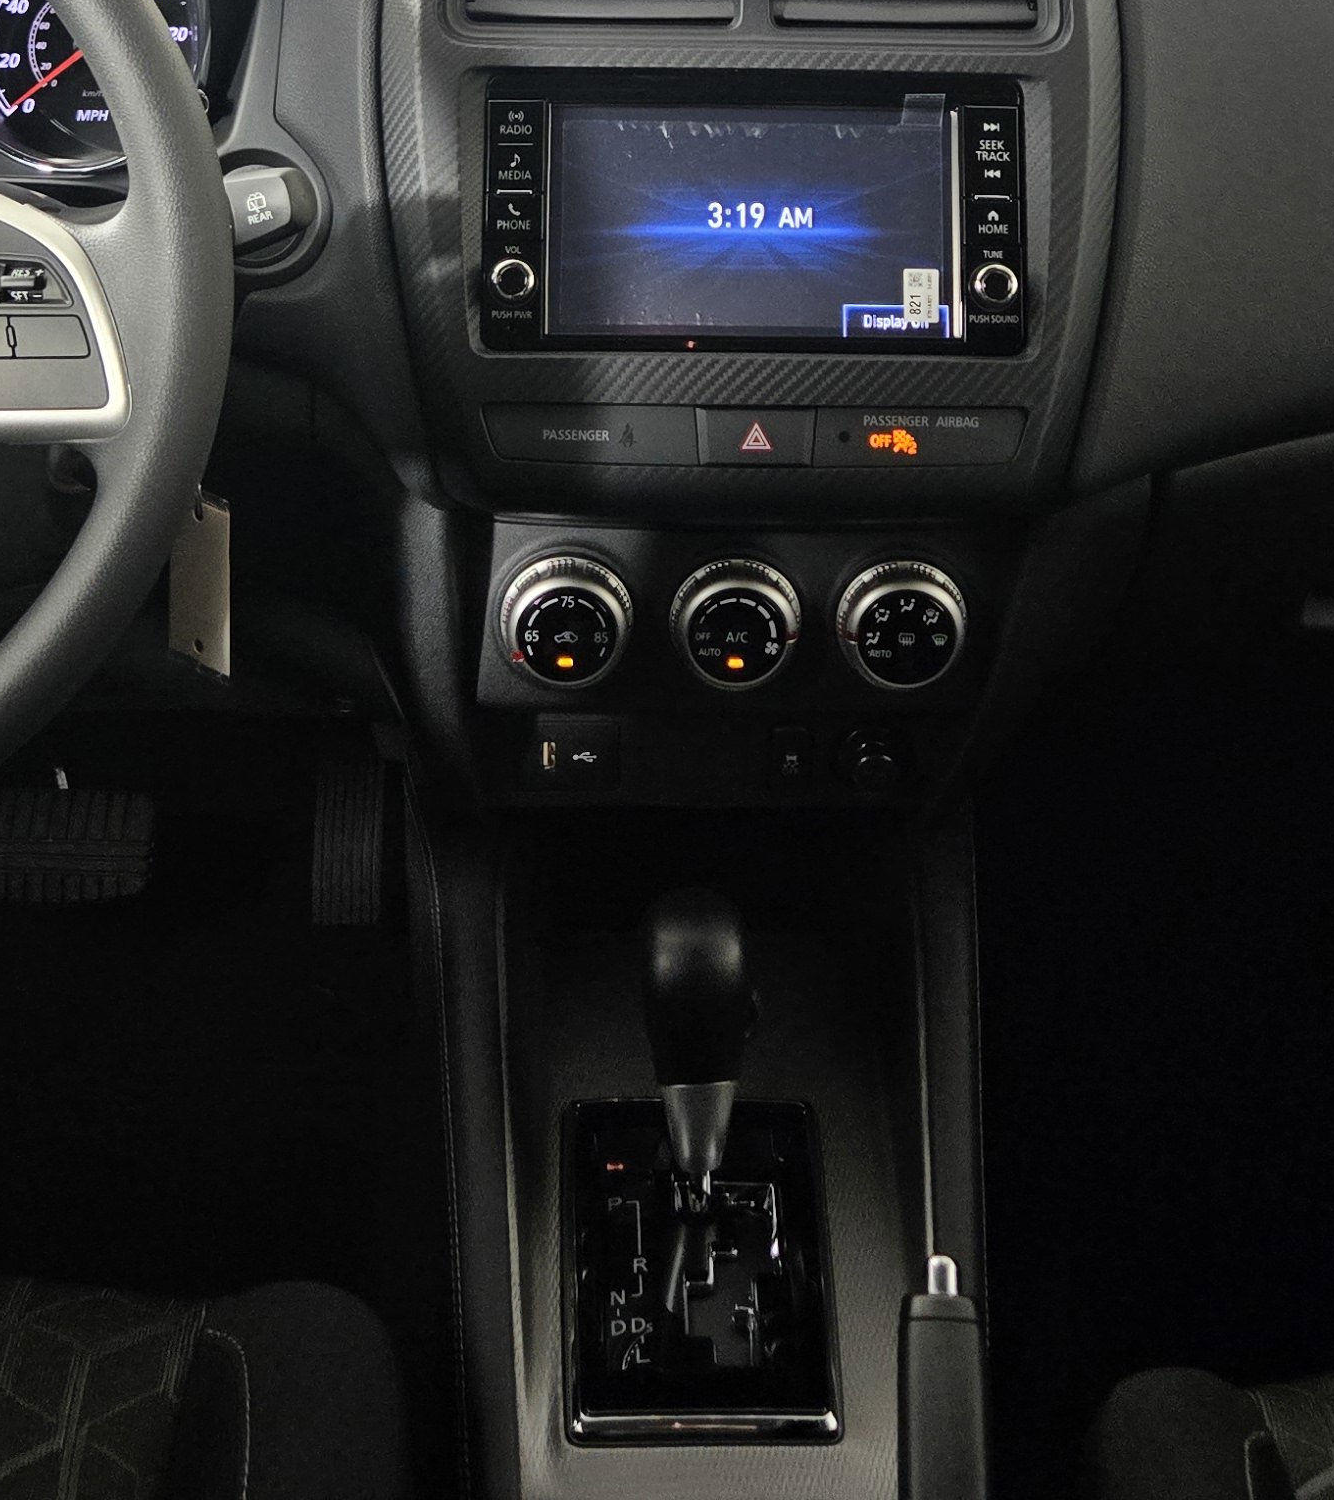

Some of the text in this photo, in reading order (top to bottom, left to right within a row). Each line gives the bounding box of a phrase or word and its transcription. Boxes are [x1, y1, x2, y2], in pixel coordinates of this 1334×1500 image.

[6, 0, 29, 14] 40
[23, 99, 35, 113] 0
[76, 109, 109, 122] MPH
[499, 124, 533, 135] RADIO
[979, 139, 1004, 150] SEEK
[976, 150, 1010, 162] TRACK
[498, 170, 532, 180] MEDIA
[247, 210, 274, 226] REAR
[707, 201, 814, 230] 3:19 AM
[496, 219, 531, 231] PHONE
[978, 223, 1009, 235] HOME
[504, 245, 521, 255] VOL
[983, 250, 1004, 259] TUNE
[909, 293, 922, 315] 821
[492, 310, 533, 319] PUSH PWR
[969, 314, 1019, 324] PUSH SOUND
[863, 314, 907, 331] Display
[863, 414, 980, 428] PASSENGER AIRBAG
[542, 428, 609, 442] PASSENGER
[869, 433, 892, 448] OFF
[560, 595, 575, 608] 75
[524, 630, 539, 642] 65
[594, 631, 608, 643] 85
[695, 632, 711, 640] OFF
[725, 631, 749, 643] A/C
[698, 648, 721, 656] AUTO
[869, 649, 892, 658] AUTO
[608, 1198, 622, 1211] P
[633, 1257, 648, 1273] R
[610, 1289, 626, 1305] N
[611, 1320, 626, 1336] D
[636, 1344, 651, 1363] L
